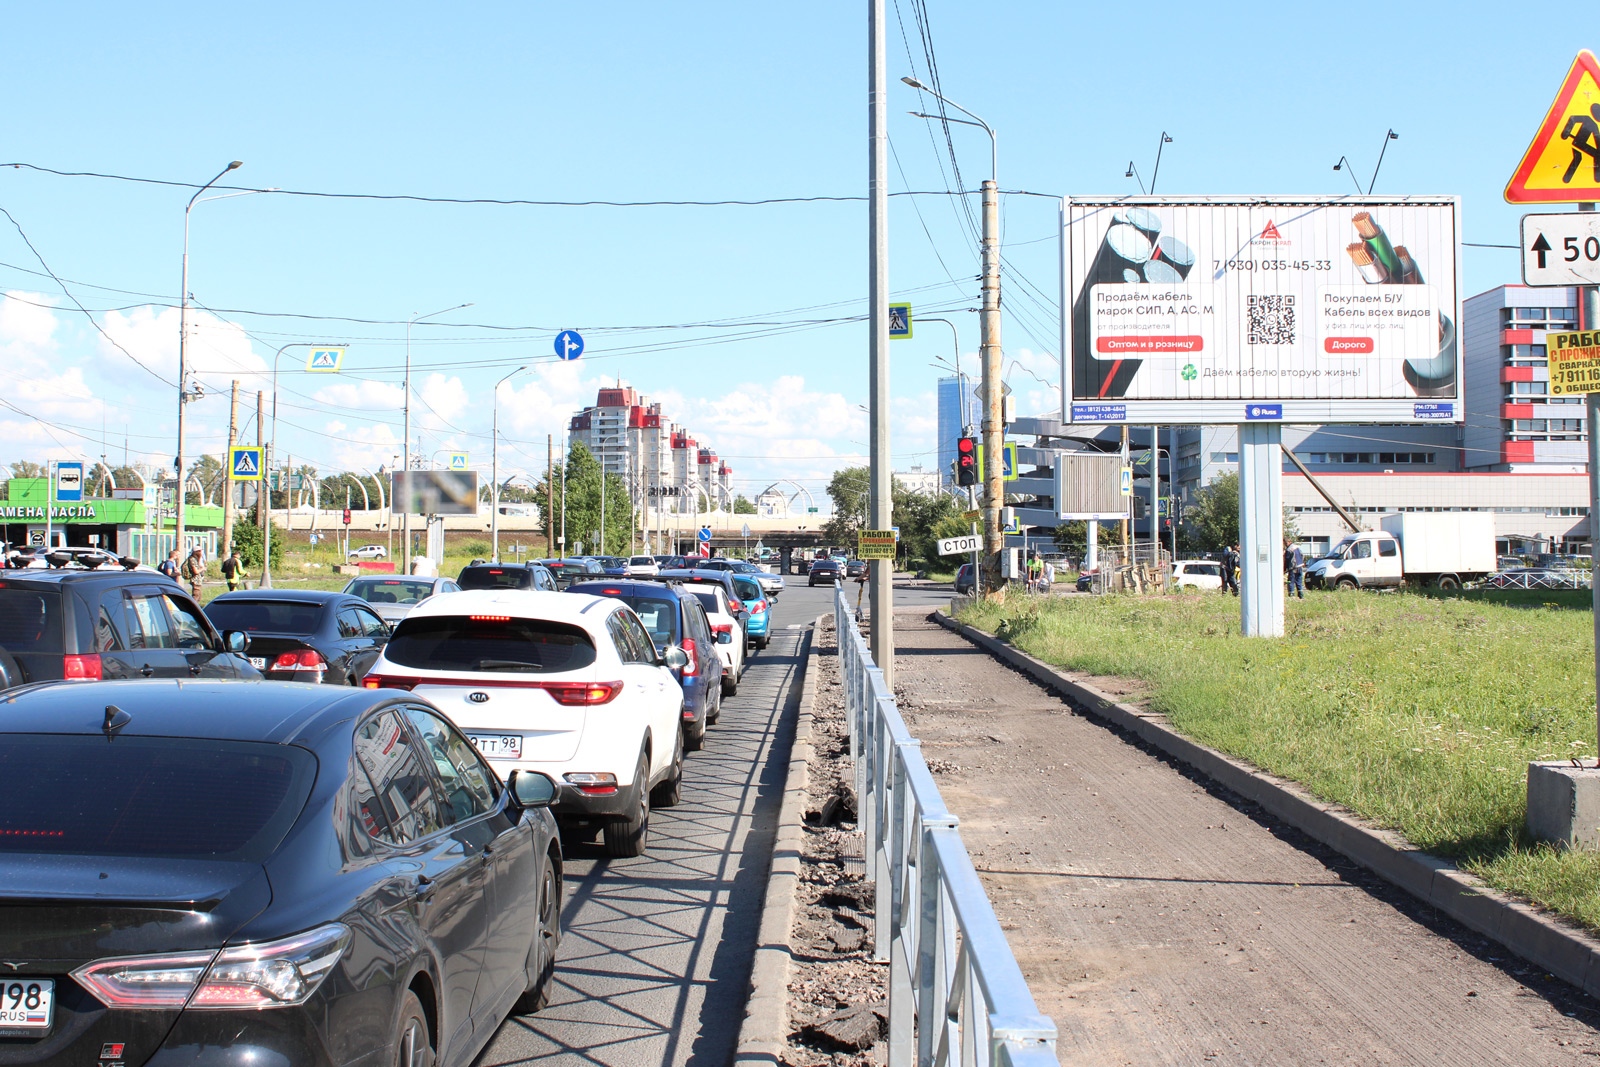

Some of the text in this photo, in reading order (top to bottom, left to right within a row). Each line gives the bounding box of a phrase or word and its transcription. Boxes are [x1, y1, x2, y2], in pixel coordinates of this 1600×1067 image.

[1563, 236, 1600, 262] 50
[1213, 259, 1332, 273] 7 (930) 035-45-33
[1097, 291, 1193, 303] Продаём кабель
[1324, 293, 1403, 305] Покупаем Б/У
[1097, 306, 1133, 317] марок
[1136, 305, 1165, 316] СИП,
[1203, 305, 1214, 315] М
[1324, 307, 1431, 318] Кабель всех видов
[1108, 323, 1171, 331] производителя
[1107, 340, 1139, 349] Оптом
[1155, 341, 1194, 350] розницу
[1332, 341, 1366, 350] Дорого
[1550, 349, 1558, 362] С
[1203, 367, 1361, 380] Даём кабелю вторую жизнь!
[50, 506, 96, 517] МАСЛА
[944, 538, 977, 552] СТОП
[471, 693, 487, 701] KIA
[502, 737, 516, 748] 98
[0, 1011, 26, 1022] RUS
